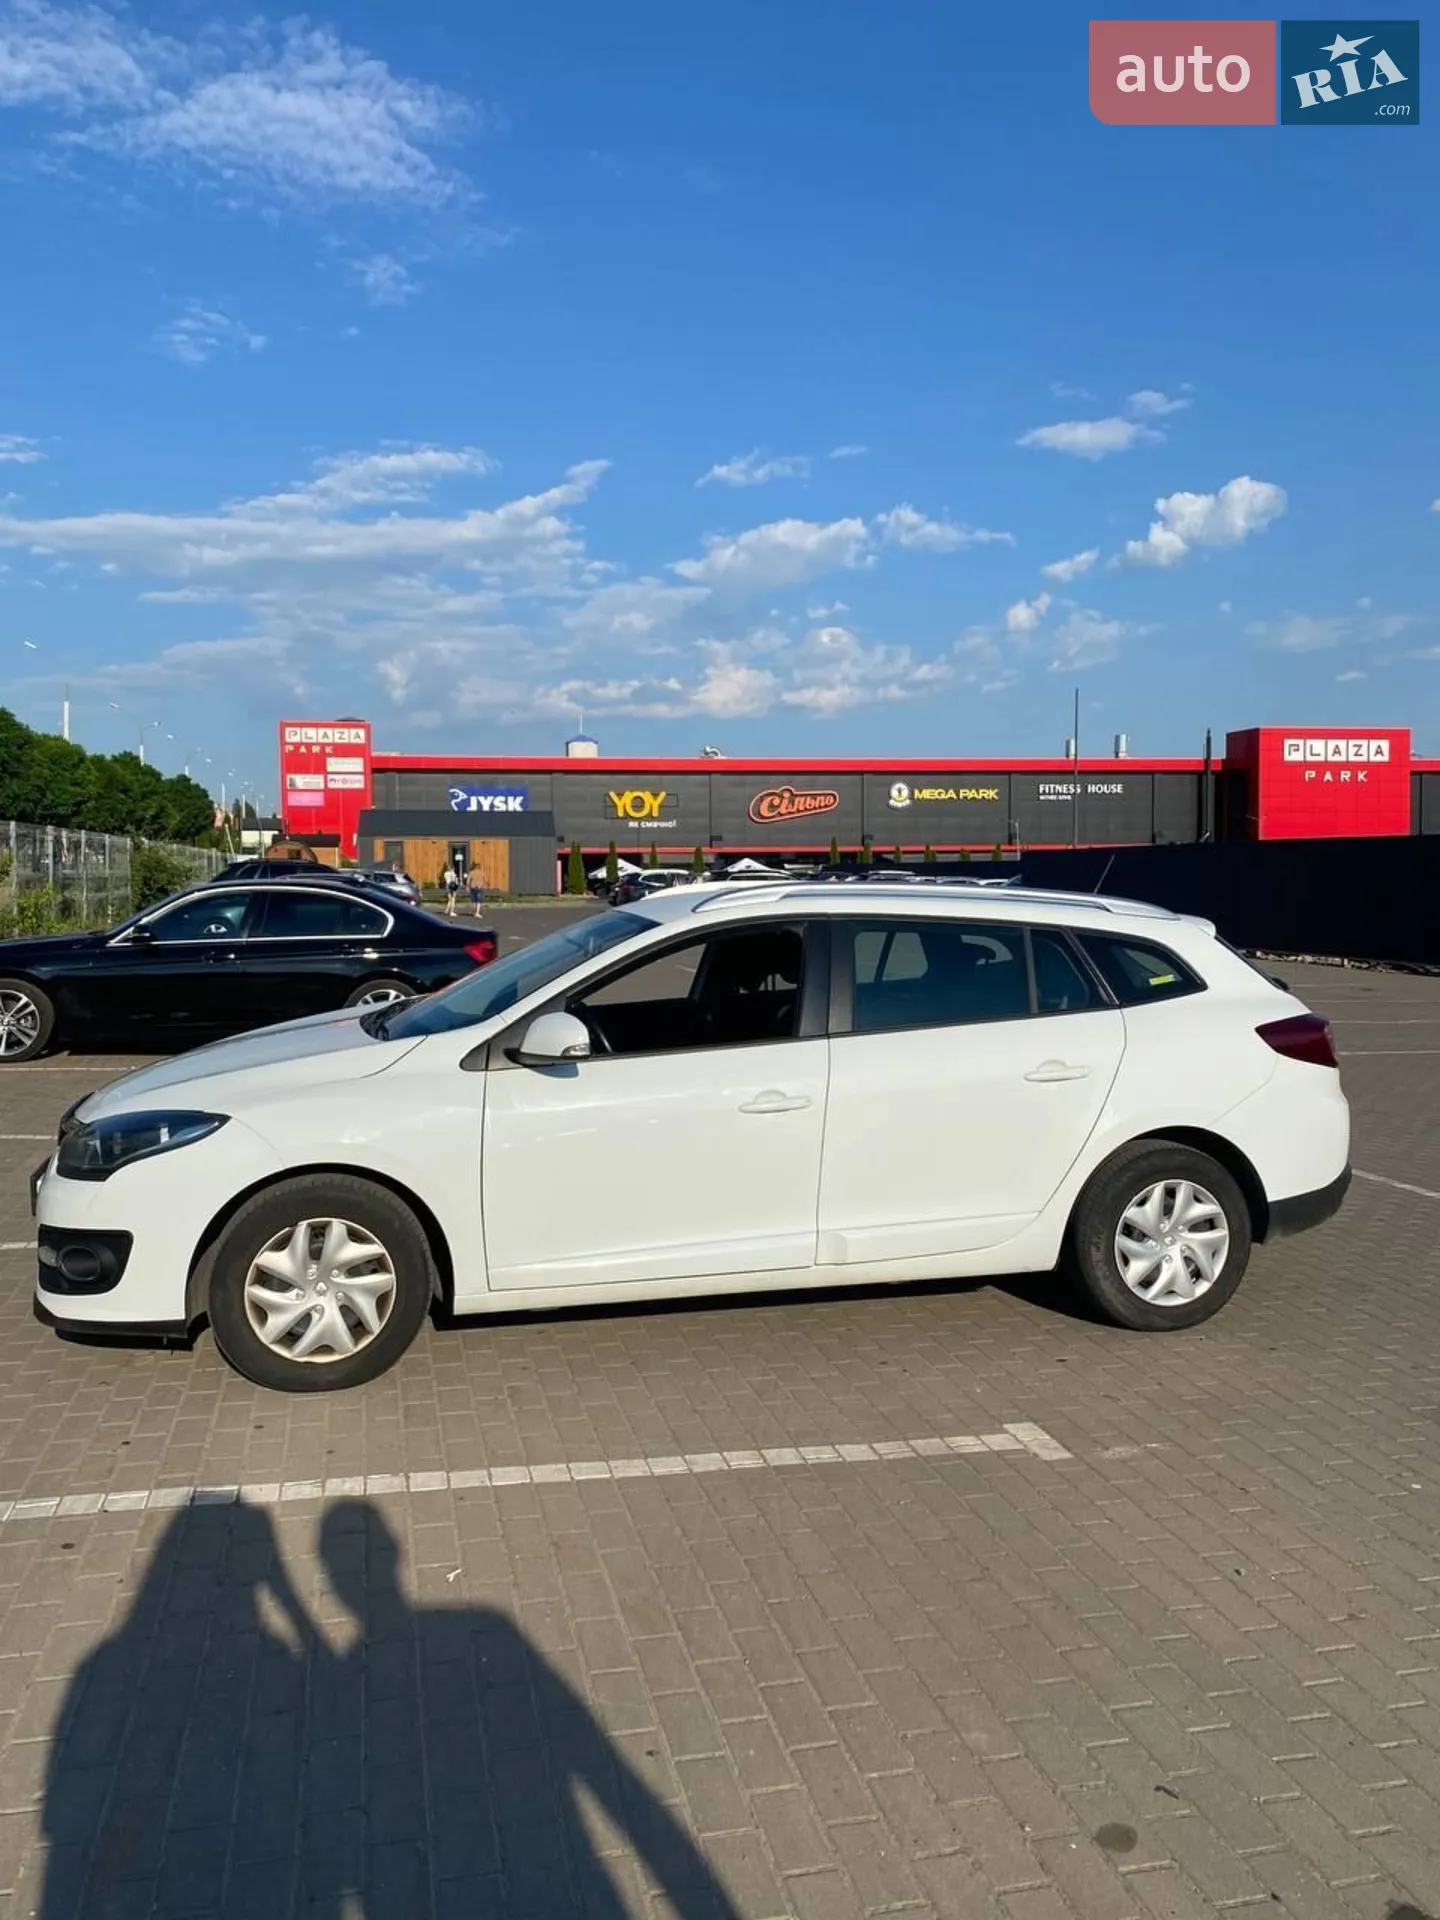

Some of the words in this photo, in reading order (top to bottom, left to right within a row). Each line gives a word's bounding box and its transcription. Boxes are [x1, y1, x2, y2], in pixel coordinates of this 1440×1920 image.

[287, 730, 362, 740] PLAZA
[285, 745, 333, 753] PARK
[1288, 744, 1385, 757] PLAZA
[1305, 770, 1368, 782] PARK
[914, 788, 957, 800] MEGA
[959, 789, 999, 800] PARK
[1039, 784, 1081, 793] FITNESS
[1087, 784, 1124, 793] HOUSE
[467, 796, 524, 811] JYSK
[609, 791, 666, 818] YOY
[760, 791, 834, 817] Сільпо
